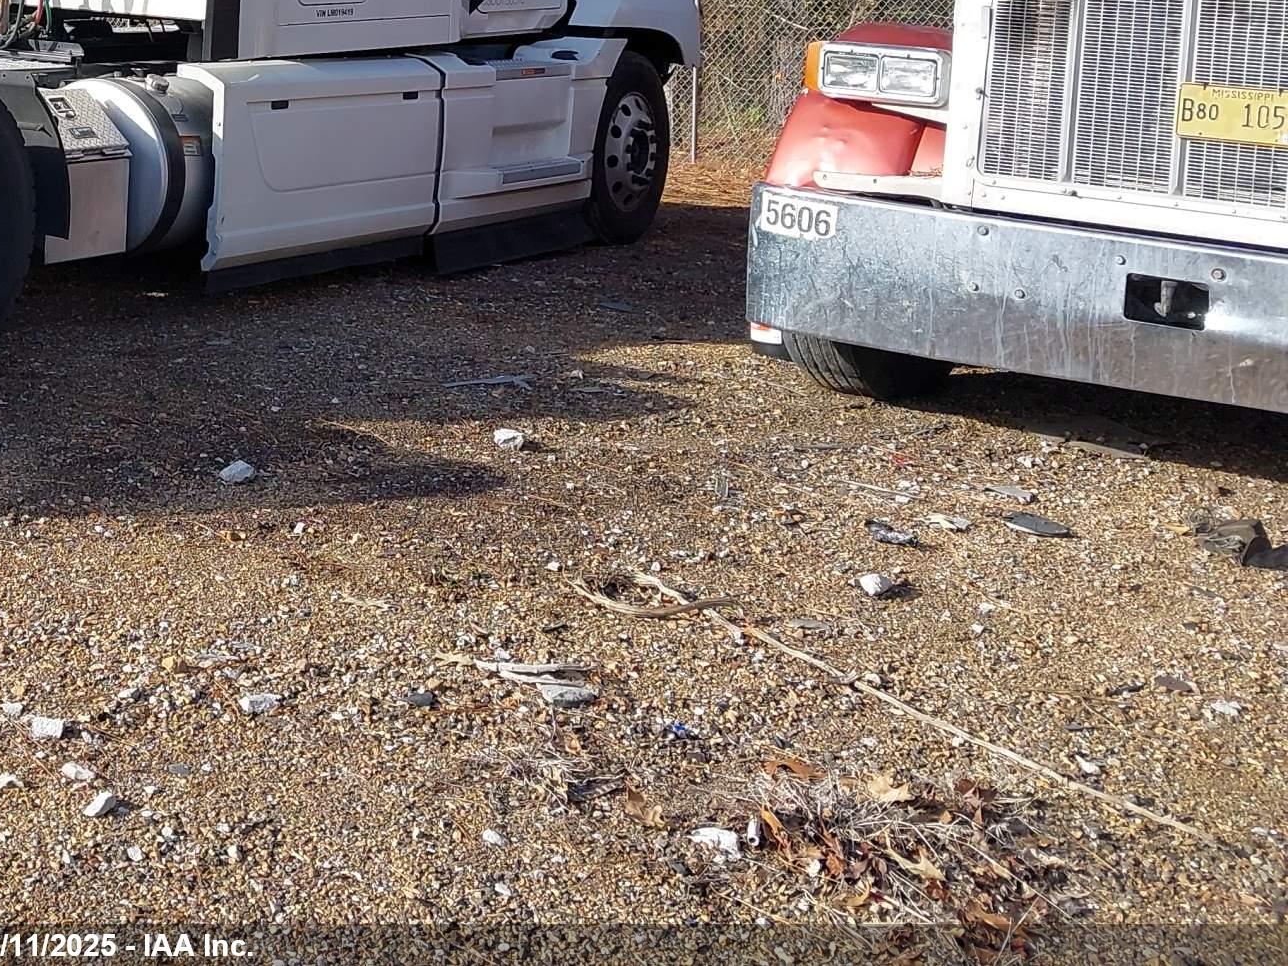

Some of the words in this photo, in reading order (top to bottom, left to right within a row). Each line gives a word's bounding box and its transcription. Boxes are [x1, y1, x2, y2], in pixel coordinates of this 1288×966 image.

[315, 9, 326, 18] VIN
[1212, 88, 1274, 102] MISSISSIPPI
[1182, 97, 1220, 123] B80
[766, 199, 832, 237] 5606
